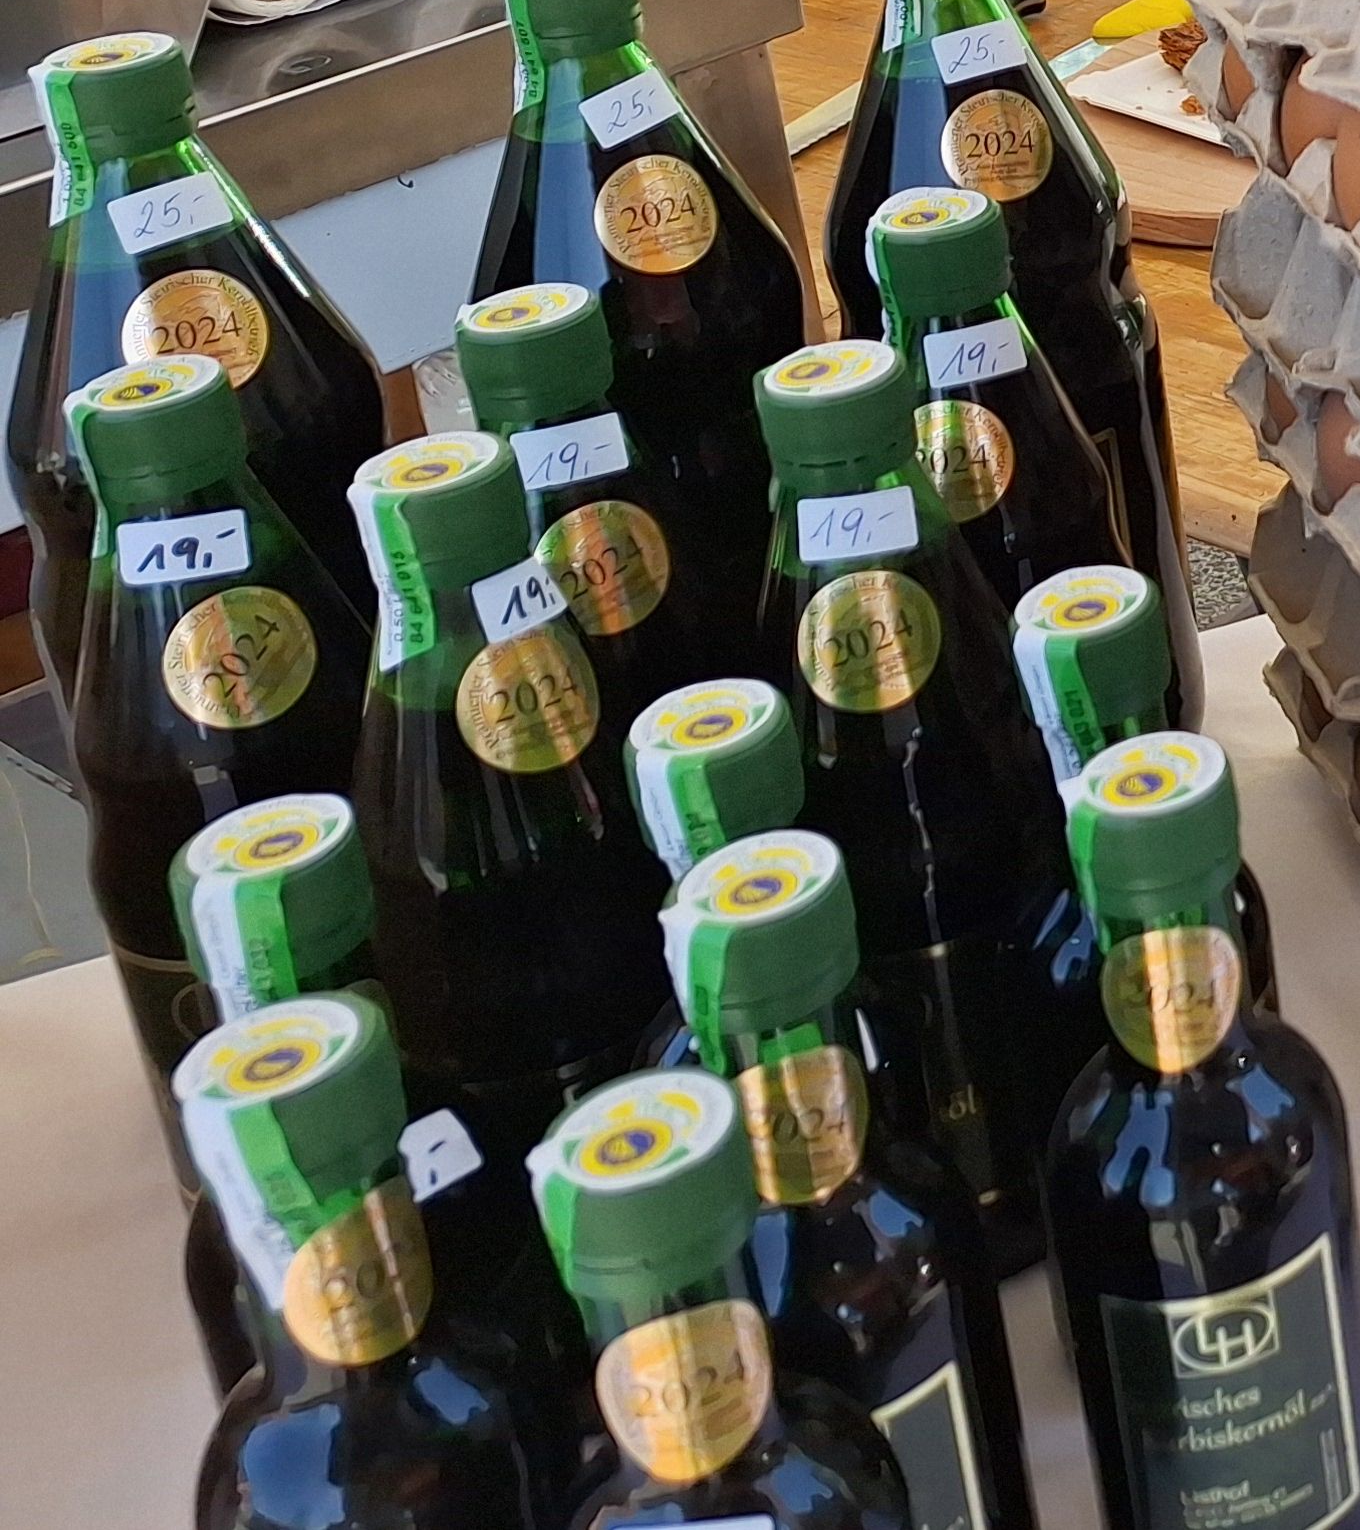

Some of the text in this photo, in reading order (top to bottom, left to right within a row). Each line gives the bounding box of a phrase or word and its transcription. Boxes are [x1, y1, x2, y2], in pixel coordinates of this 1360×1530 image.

[964, 130, 1035, 159] 2024
[620, 191, 696, 234] 2024
[152, 310, 243, 355] 2024
[137, 527, 237, 572] 19,-
[559, 535, 645, 601] 2024
[202, 611, 282, 700] 2024
[823, 608, 914, 669] 2024
[489, 672, 578, 724] 2024
[1178, 1388, 1306, 1453] rbiskernöl
